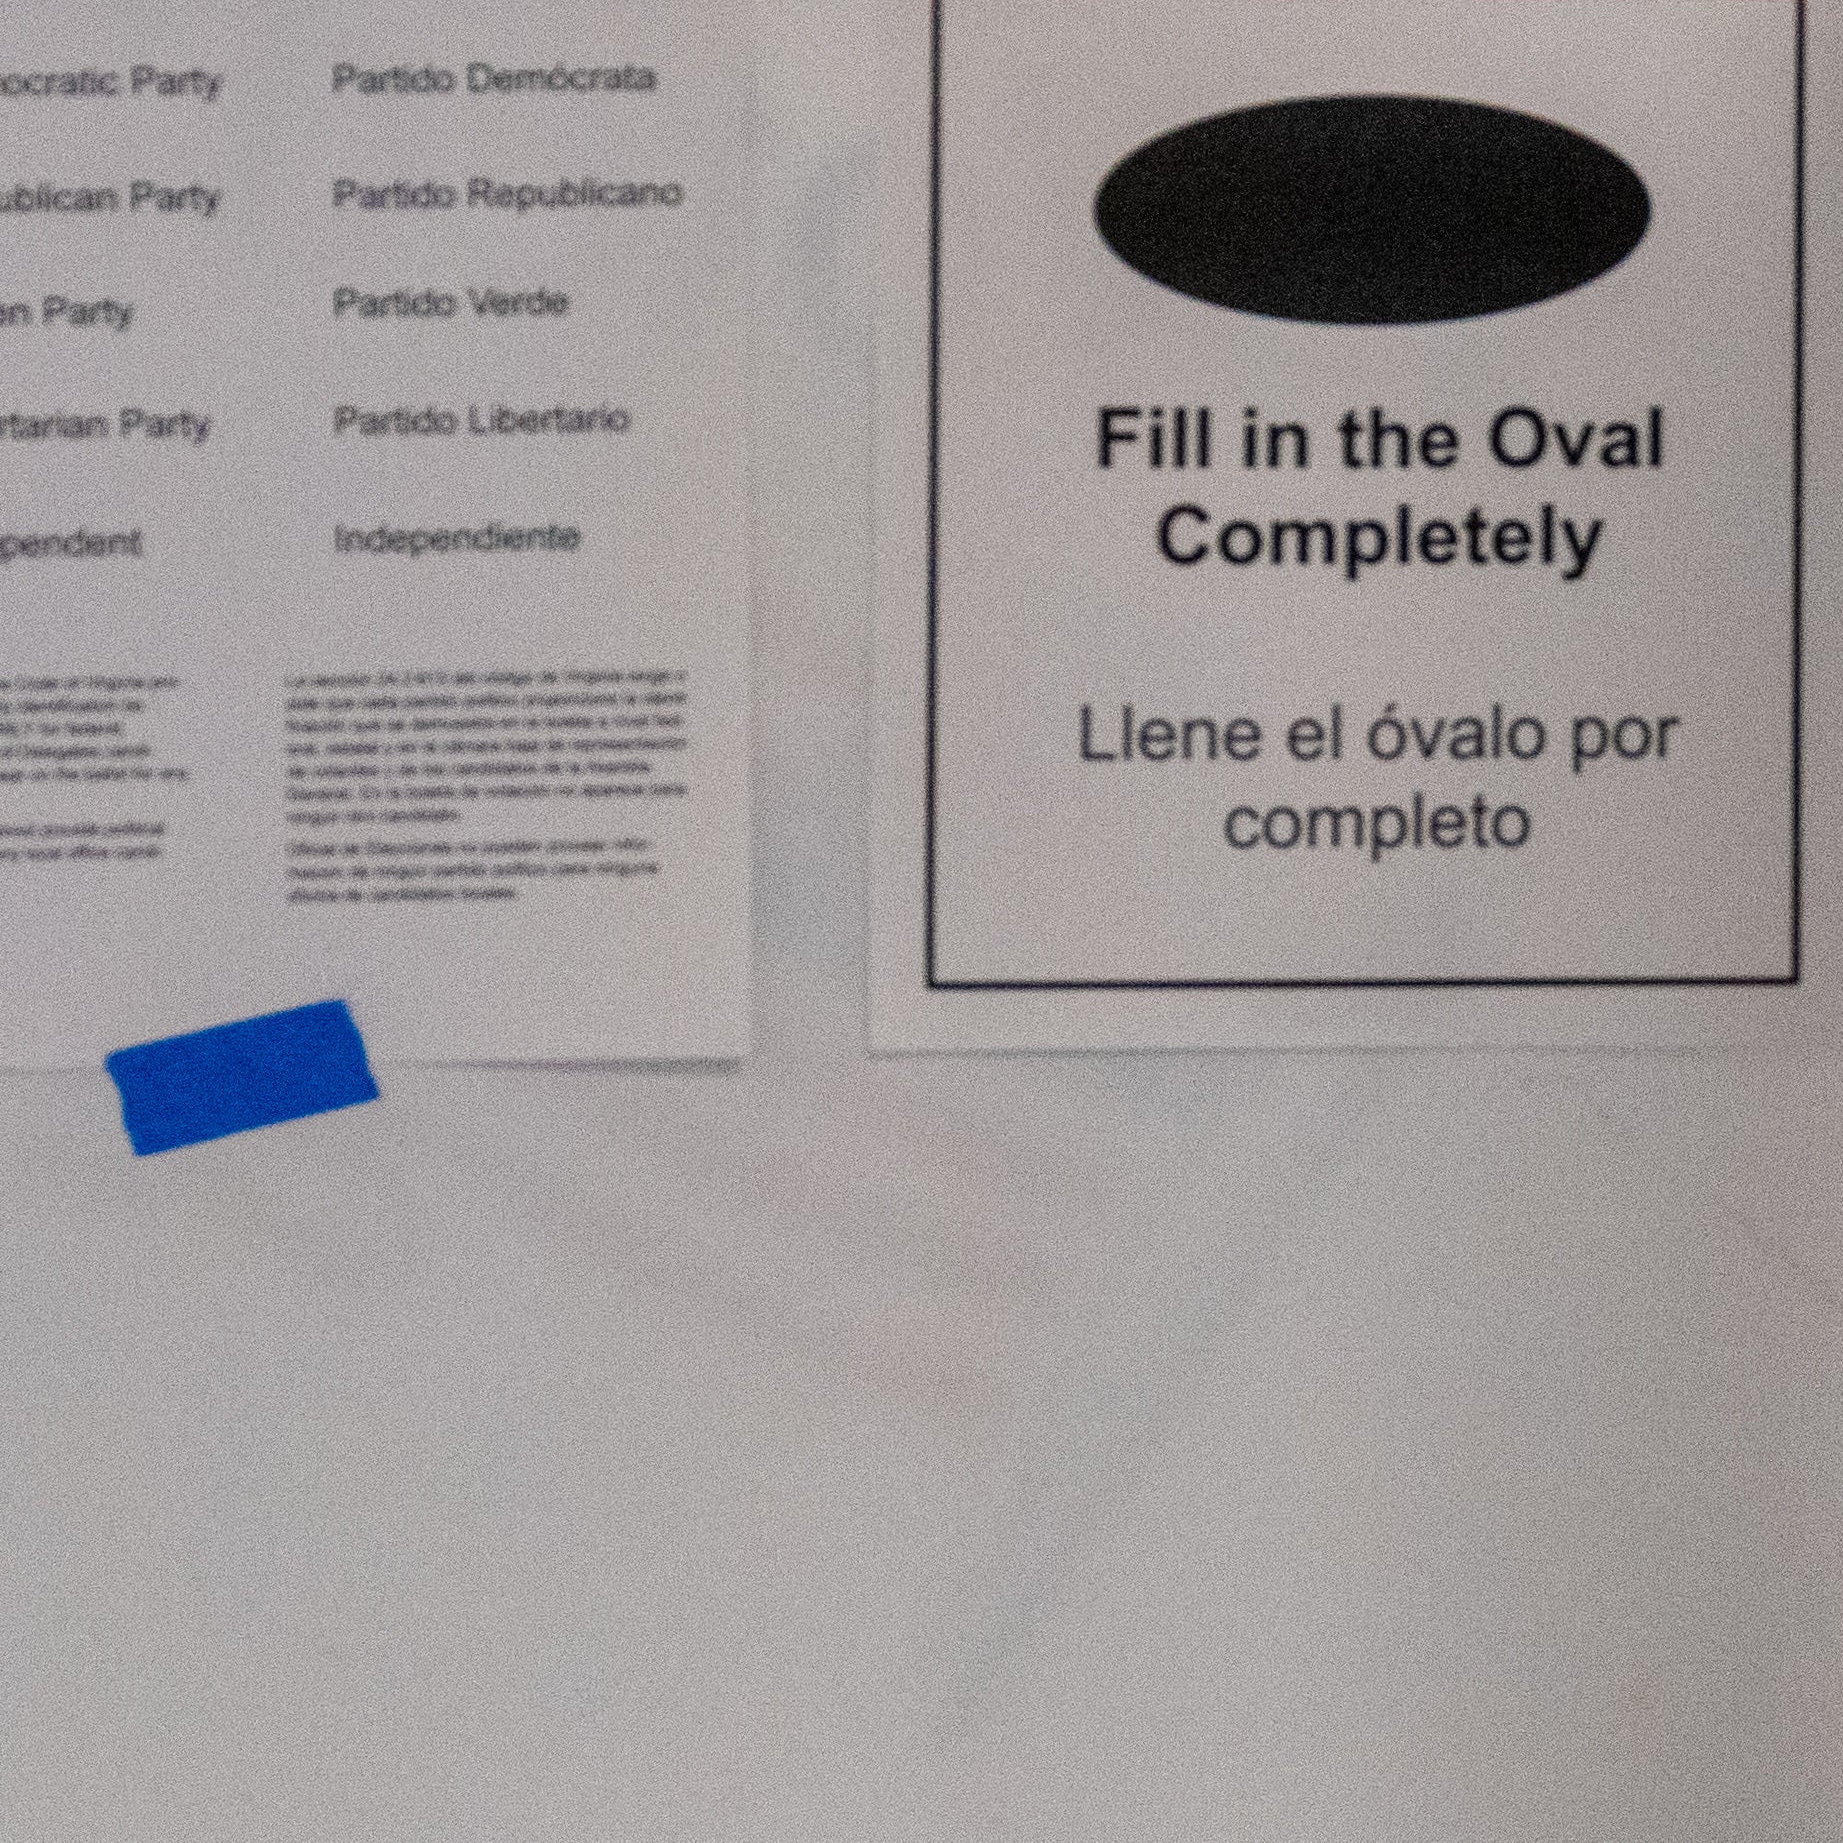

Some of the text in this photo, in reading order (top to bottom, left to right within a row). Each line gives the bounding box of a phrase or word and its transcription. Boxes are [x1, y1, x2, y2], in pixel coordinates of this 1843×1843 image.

[130, 64, 223, 103] Party
[332, 61, 659, 96] Partido Demócrata
[129, 180, 222, 218] Party
[332, 176, 685, 214] Partido Republicano
[42, 294, 134, 332] Party
[332, 286, 571, 319] Partido Verde
[119, 407, 212, 445] Party
[333, 404, 632, 437] Partido Libertario
[1098, 405, 1663, 470] Fill in the Oval
[334, 522, 582, 558] Independiente
[1156, 502, 1605, 583] Completely
[1079, 702, 1681, 775] Llene el óvalo por
[1223, 791, 1533, 864] completo
